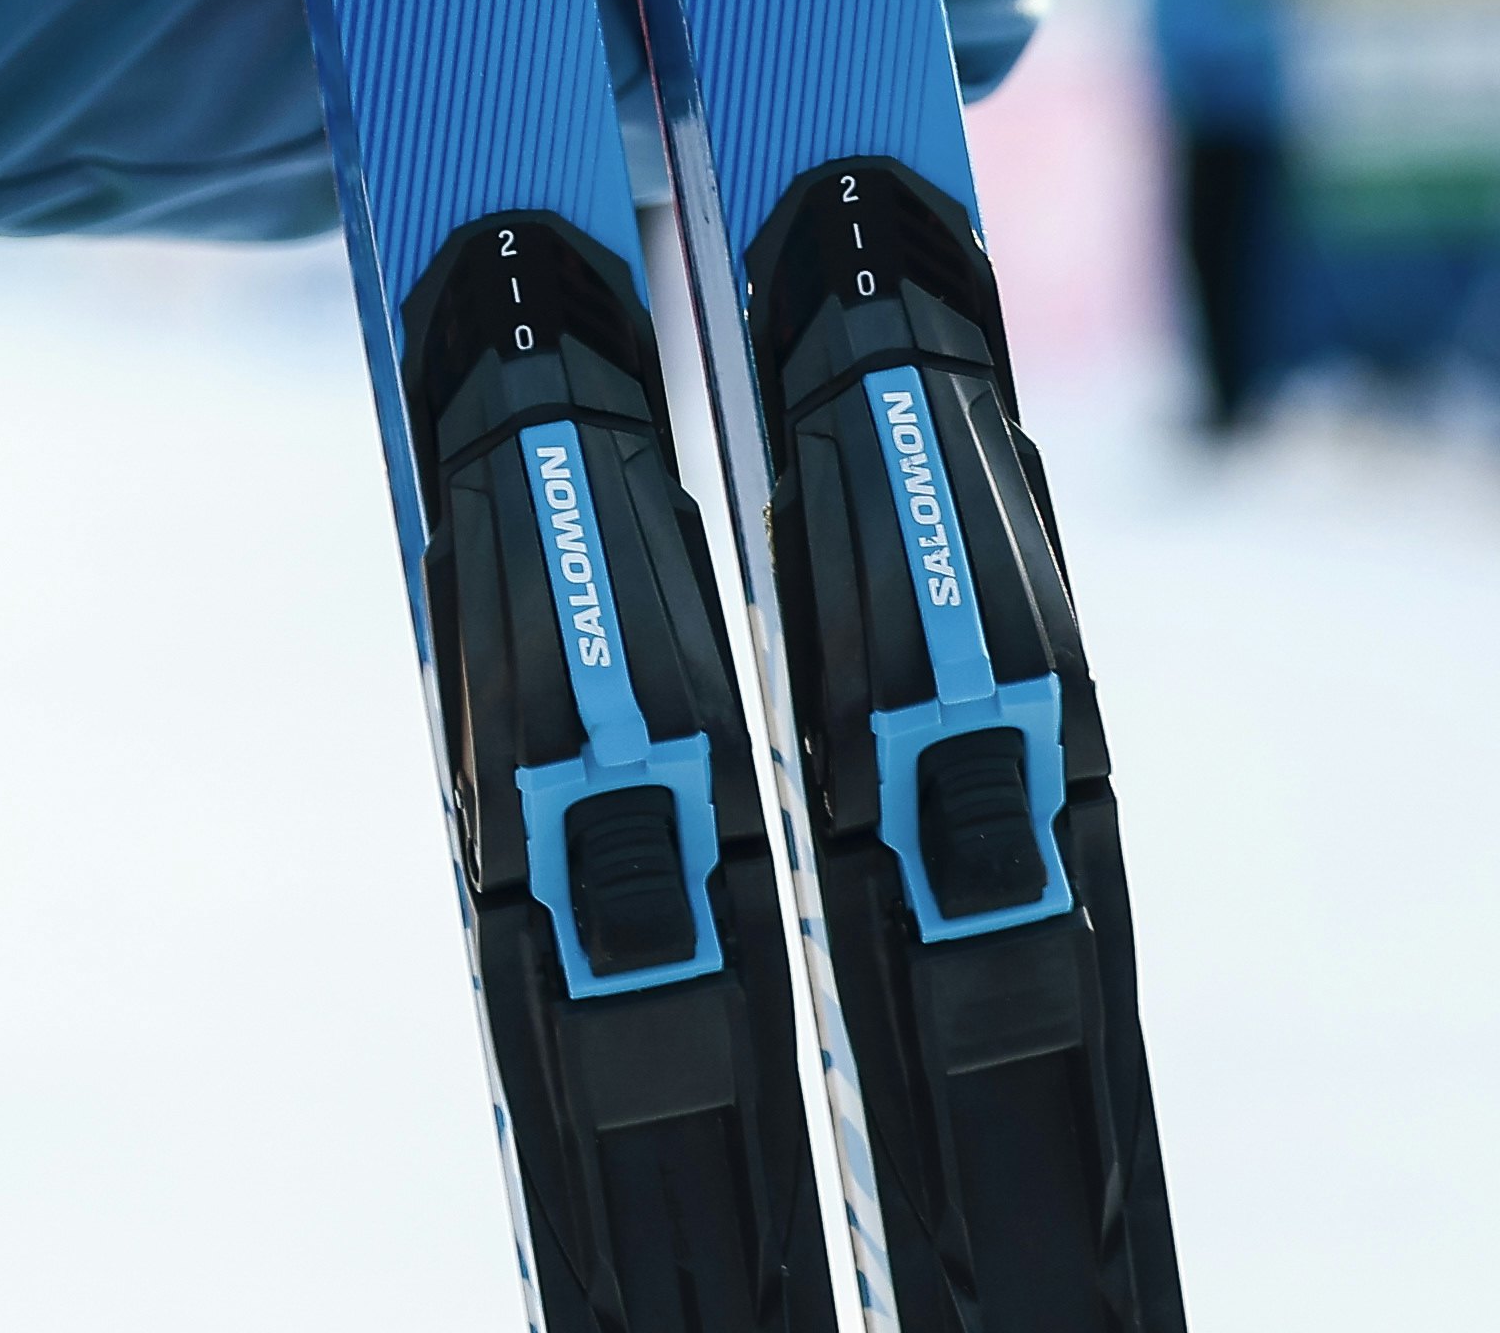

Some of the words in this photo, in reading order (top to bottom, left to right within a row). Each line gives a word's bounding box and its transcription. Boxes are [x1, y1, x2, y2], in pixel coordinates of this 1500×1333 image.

[840, 175, 859, 203] 2
[499, 229, 518, 257] 2
[855, 270, 876, 297] 0
[515, 324, 534, 351] 0
[881, 390, 962, 607] SALOMON
[536, 446, 611, 668] SALOMON
